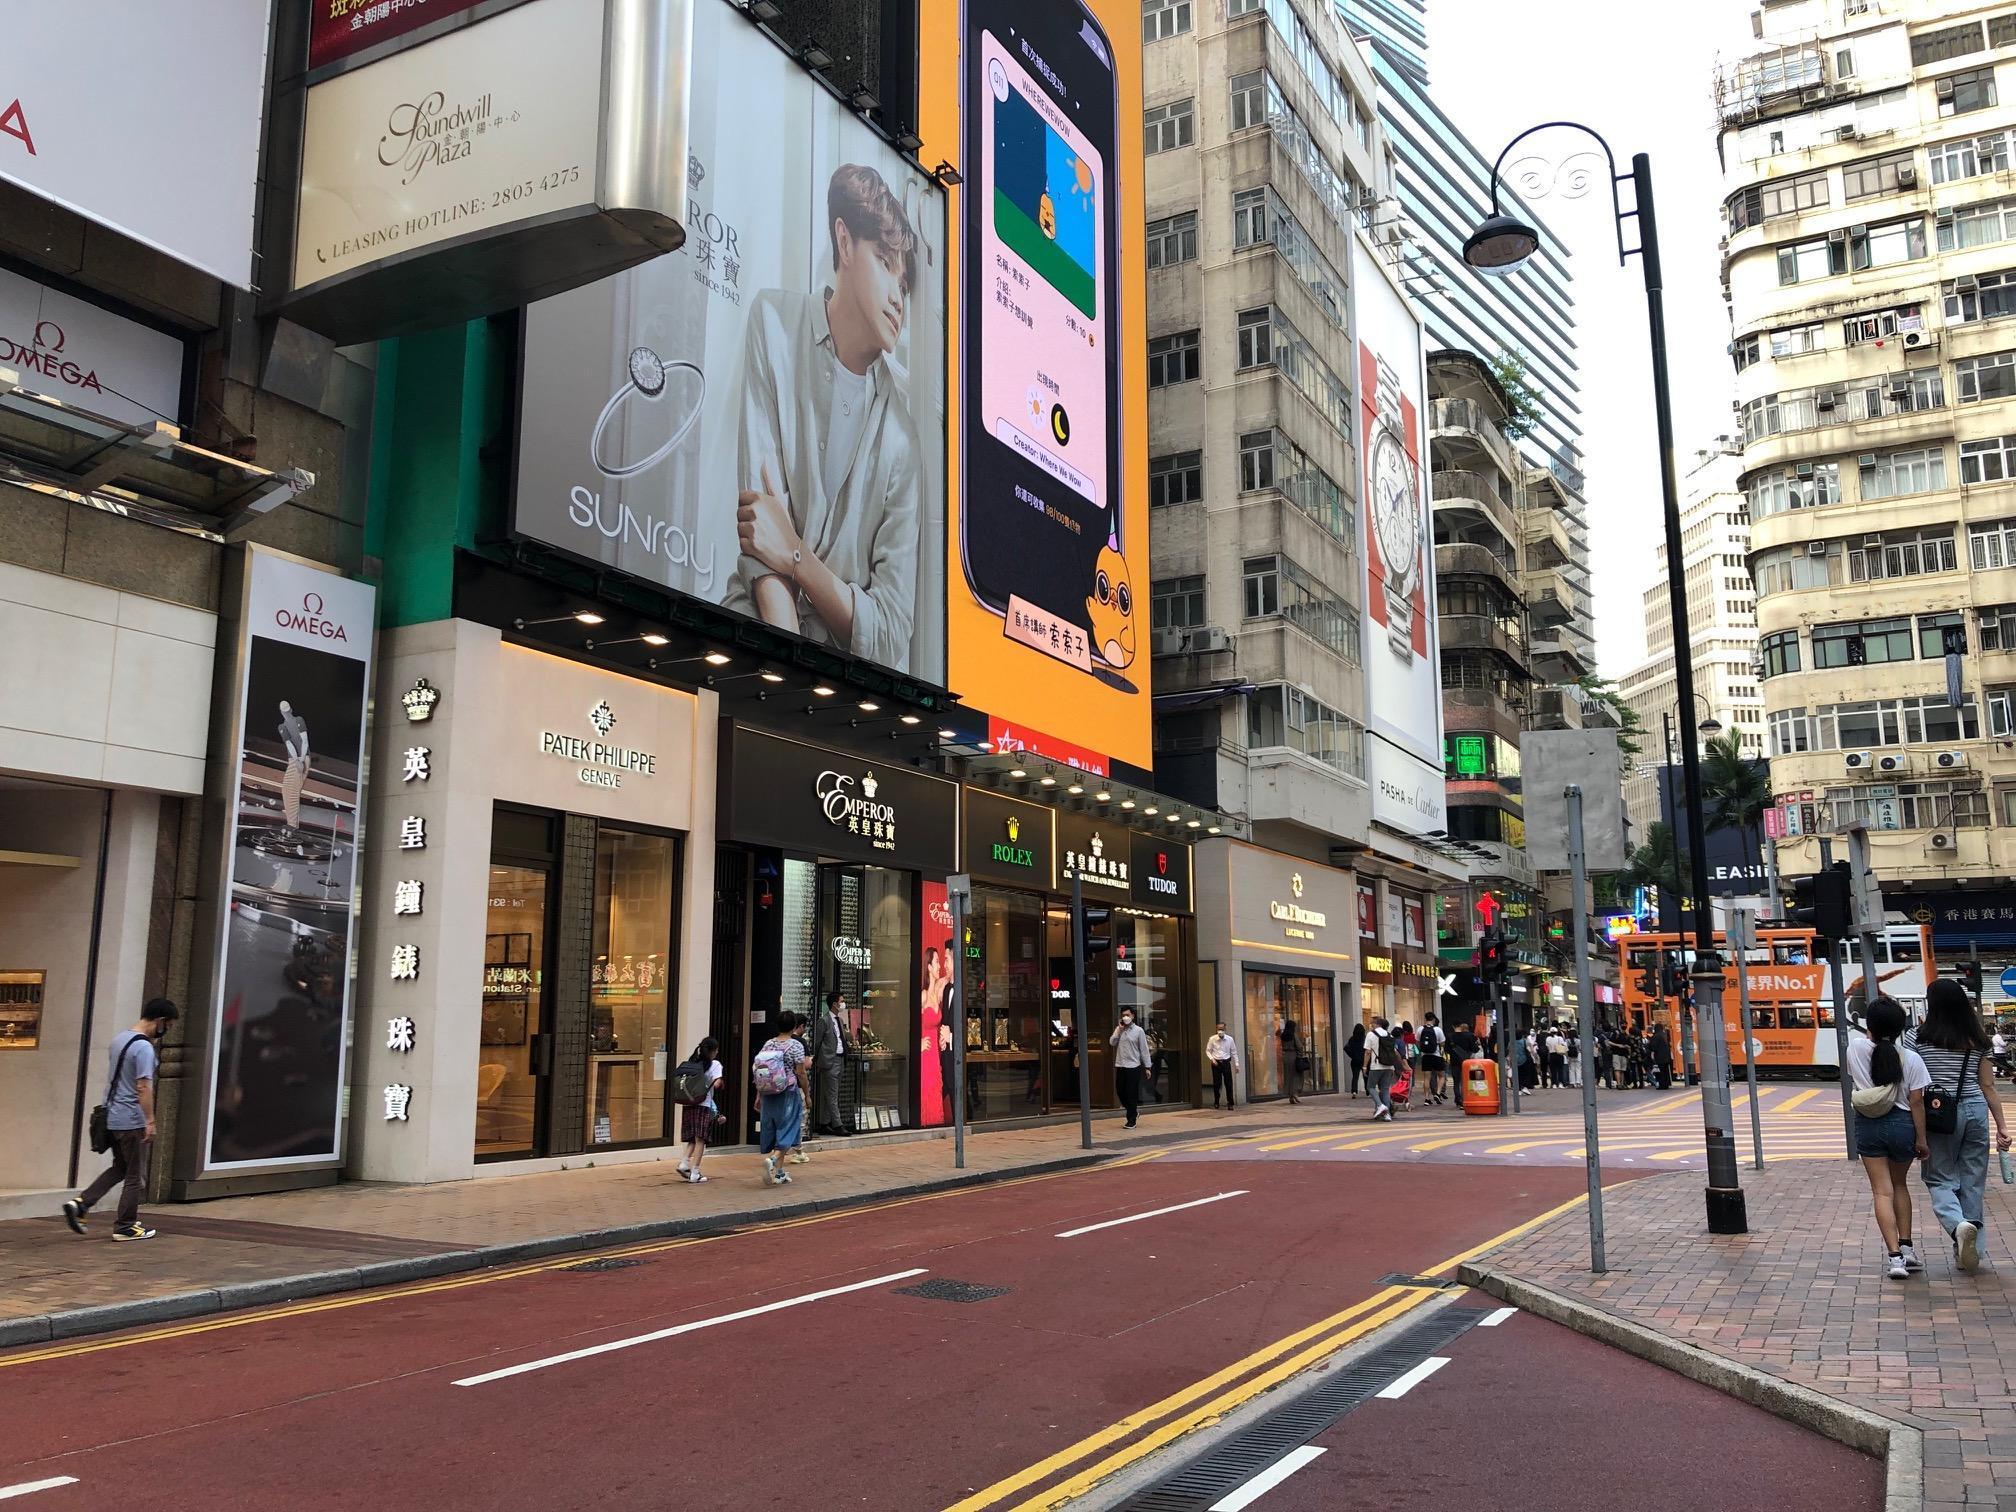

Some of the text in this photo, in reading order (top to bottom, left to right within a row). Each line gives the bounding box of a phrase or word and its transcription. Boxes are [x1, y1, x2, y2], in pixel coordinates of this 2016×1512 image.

[378, 91, 491, 166] Soundwill
[1022, 78, 1071, 138] WHEREWEWOW
[402, 140, 471, 185] Plaza
[332, 166, 580, 258] LEASING HOTLINE: 2803 4275
[694, 269, 740, 306] since 1942
[1013, 434, 1082, 488] Creator: Where We Wow
[569, 485, 714, 592] SUNray
[276, 609, 347, 642] OMEGA
[543, 731, 656, 774] PATEK PHILIPPE
[580, 768, 621, 788] GENEVE
[816, 770, 895, 825] EMPEROR
[1380, 780, 1440, 819] PASHA DE Cartier
[848, 815, 895, 840] 英皇珠寶
[873, 839, 886, 849] since
[993, 843, 1033, 867] ROLEX
[1707, 865, 1776, 880] EASI
[1149, 876, 1177, 895] TUDOR
[383, 746, 430, 1121] 英皇鐘錶珠寶
